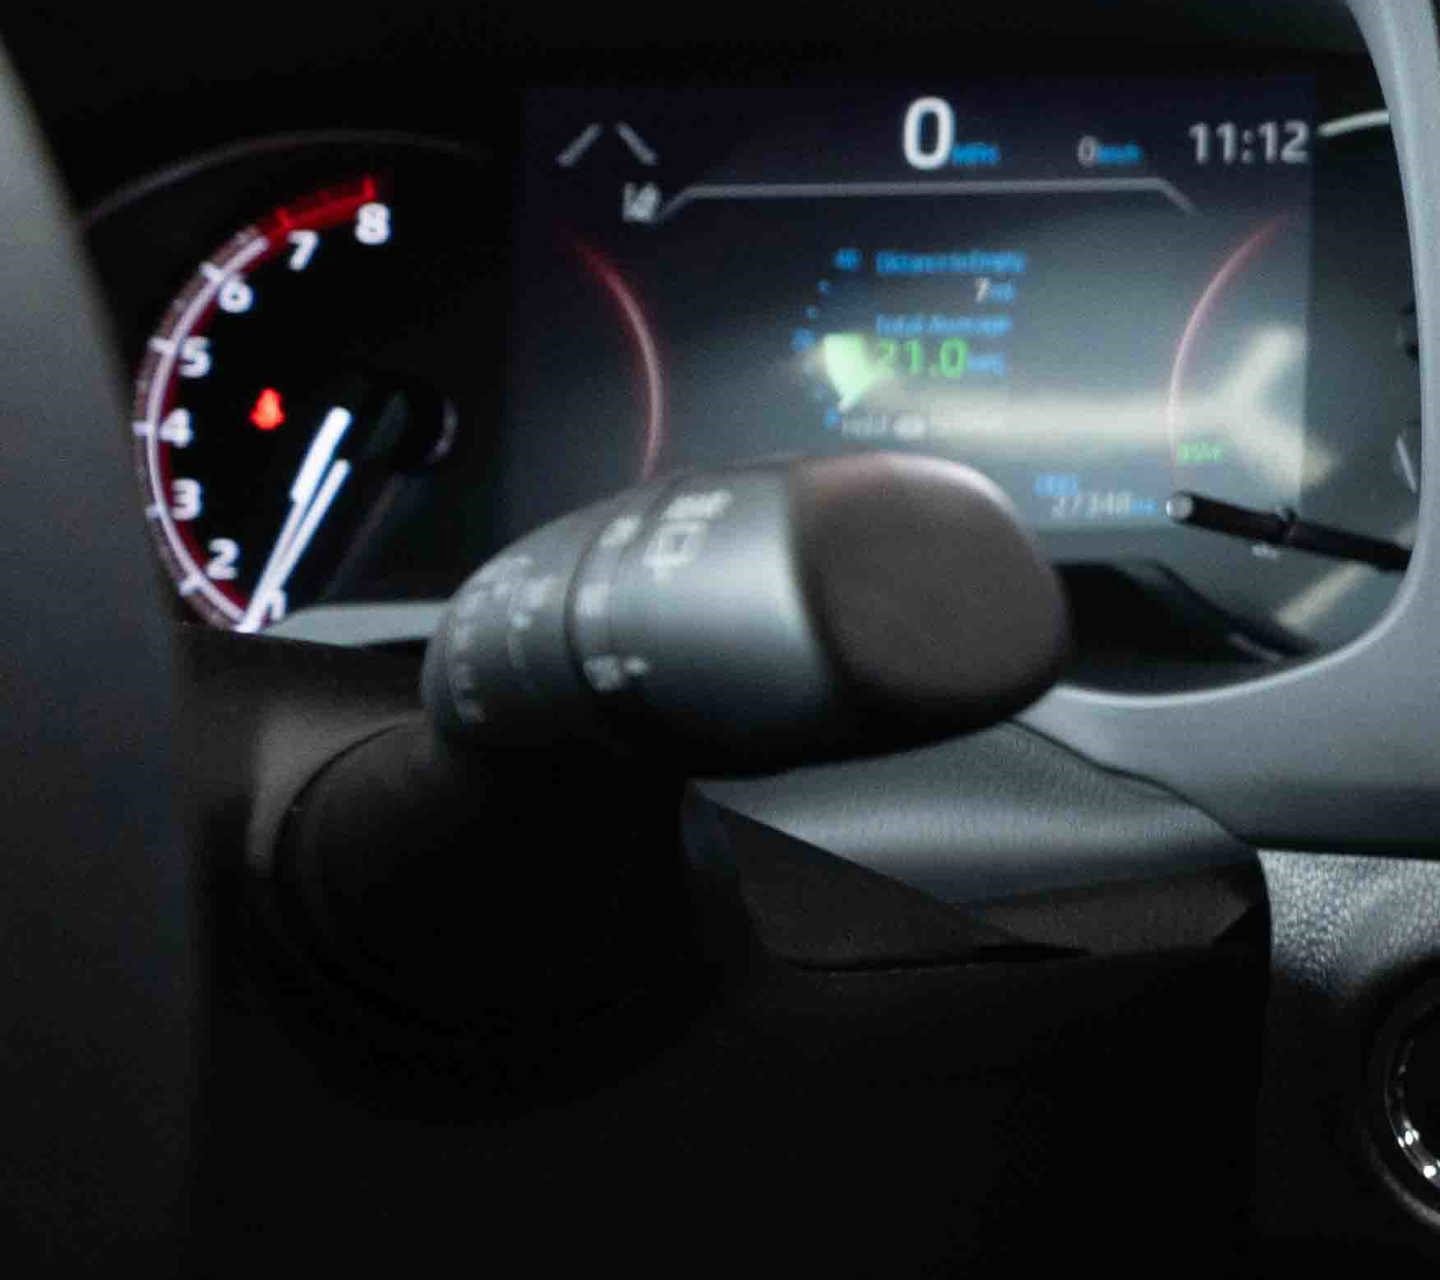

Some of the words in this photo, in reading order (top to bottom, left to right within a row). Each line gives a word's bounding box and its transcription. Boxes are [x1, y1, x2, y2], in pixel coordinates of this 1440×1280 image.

[903, 97, 953, 170] 0
[1190, 121, 1308, 164] 11:12
[354, 201, 391, 246] 8
[287, 228, 320, 272] 7
[219, 277, 253, 314] 6
[179, 335, 211, 379] 5
[160, 406, 194, 449] 4
[171, 477, 202, 521] 3
[206, 537, 240, 581] 2
